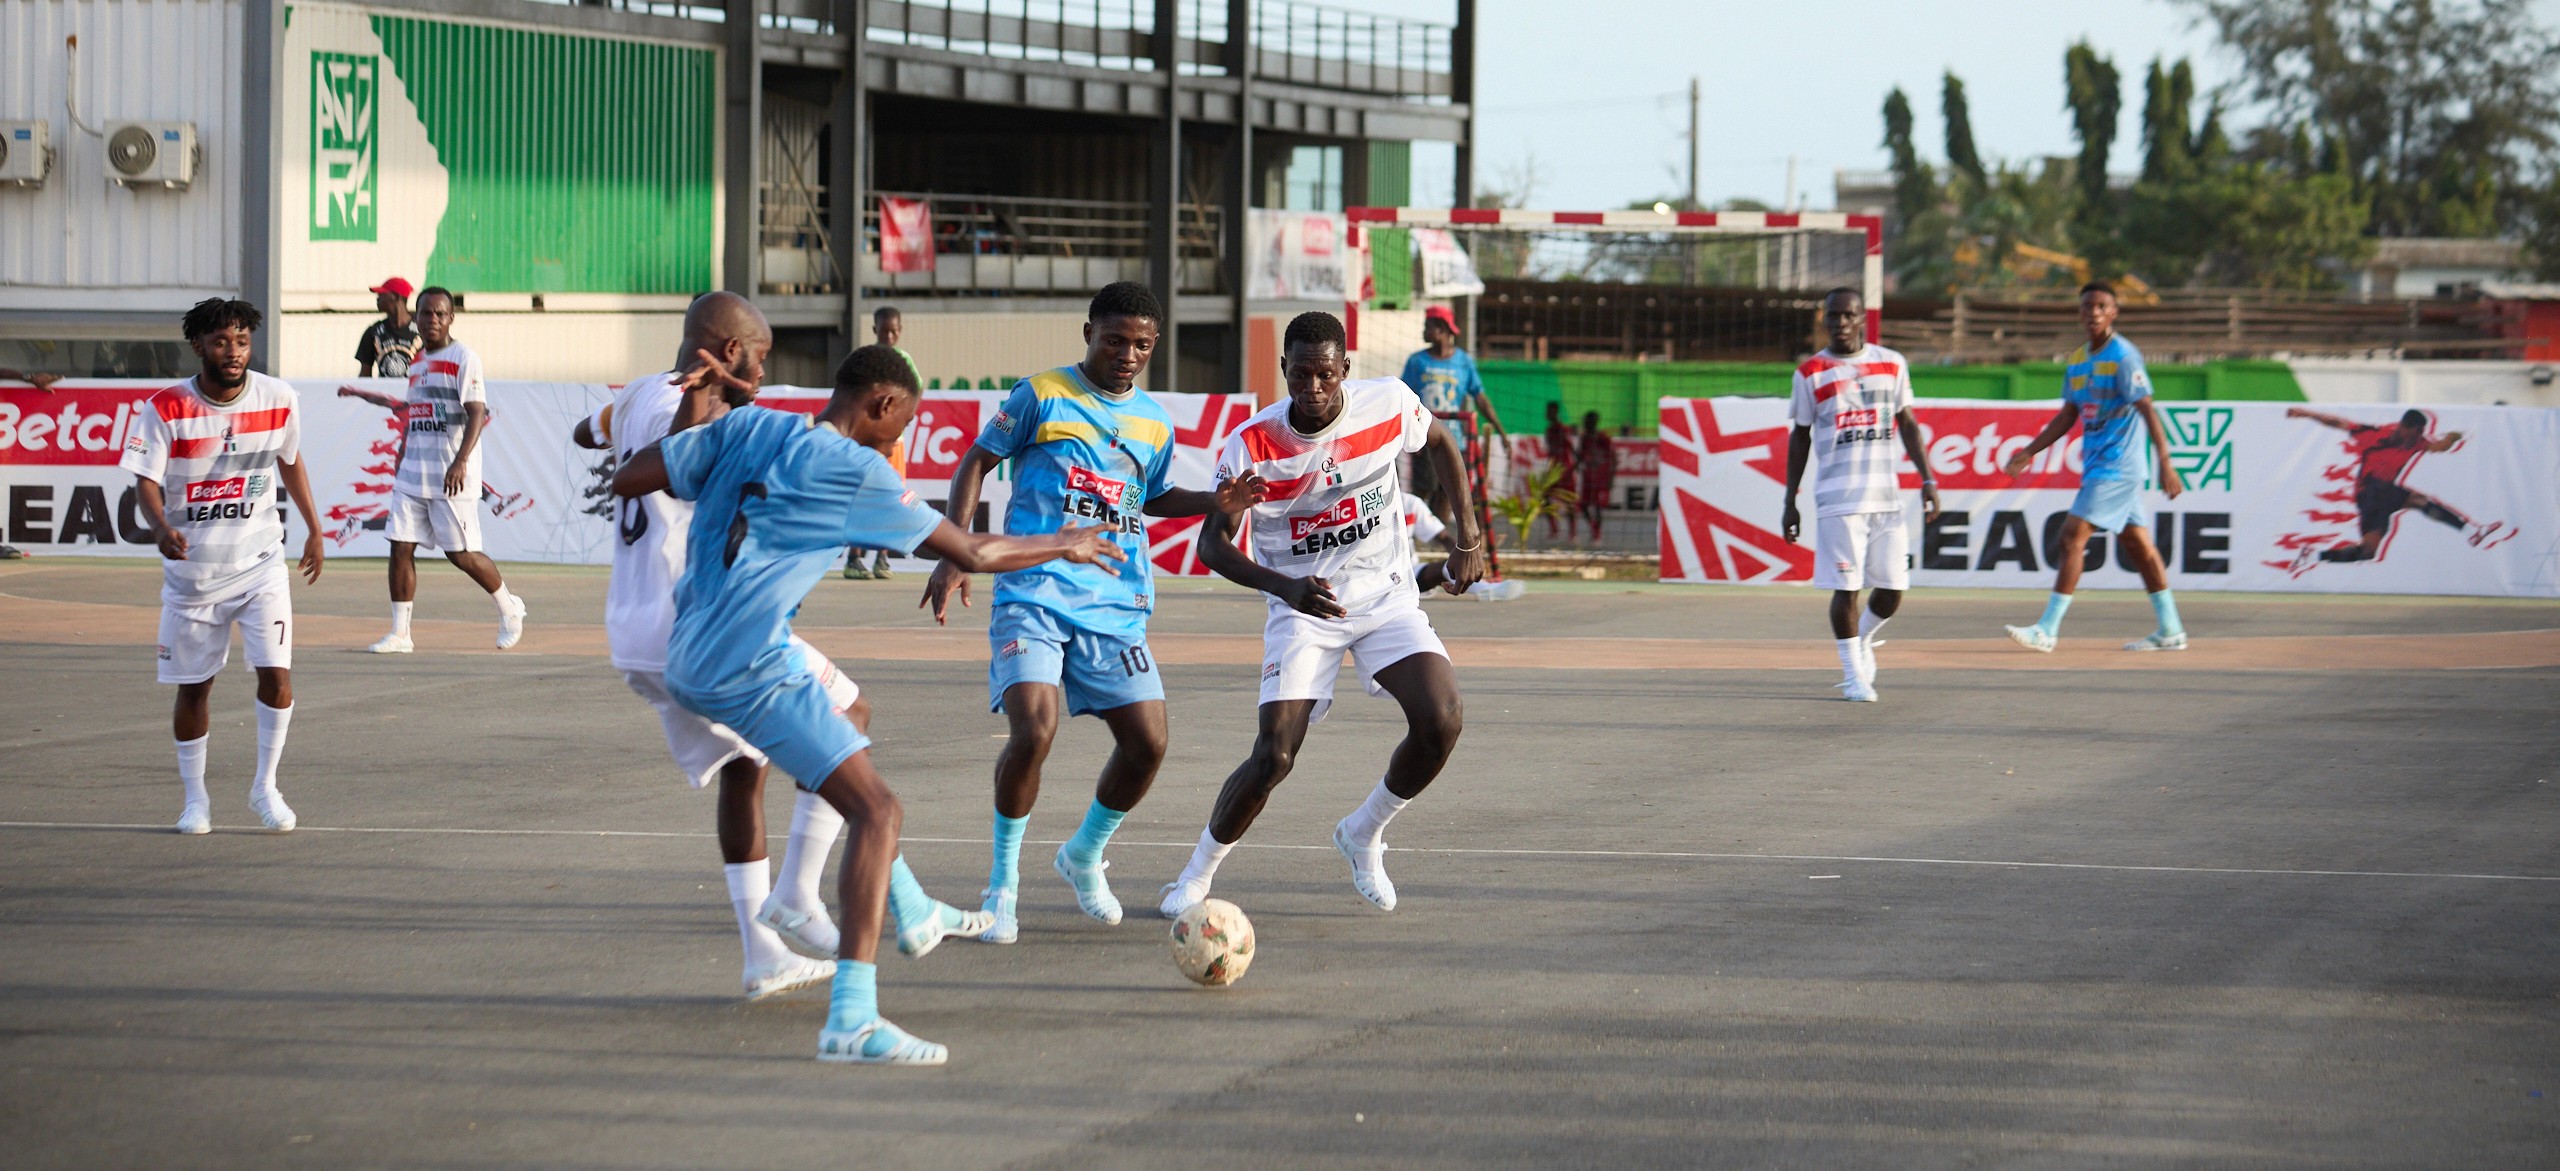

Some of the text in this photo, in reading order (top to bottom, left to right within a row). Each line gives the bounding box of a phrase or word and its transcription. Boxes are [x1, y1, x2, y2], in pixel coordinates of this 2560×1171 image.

[0, 401, 146, 451] Betcli
[190, 480, 242, 500] Betclic
[187, 503, 255, 522] LEAGU
[1297, 505, 1352, 537] Beclic
[273, 620, 285, 646] 7
[1119, 645, 1150, 677] 10
